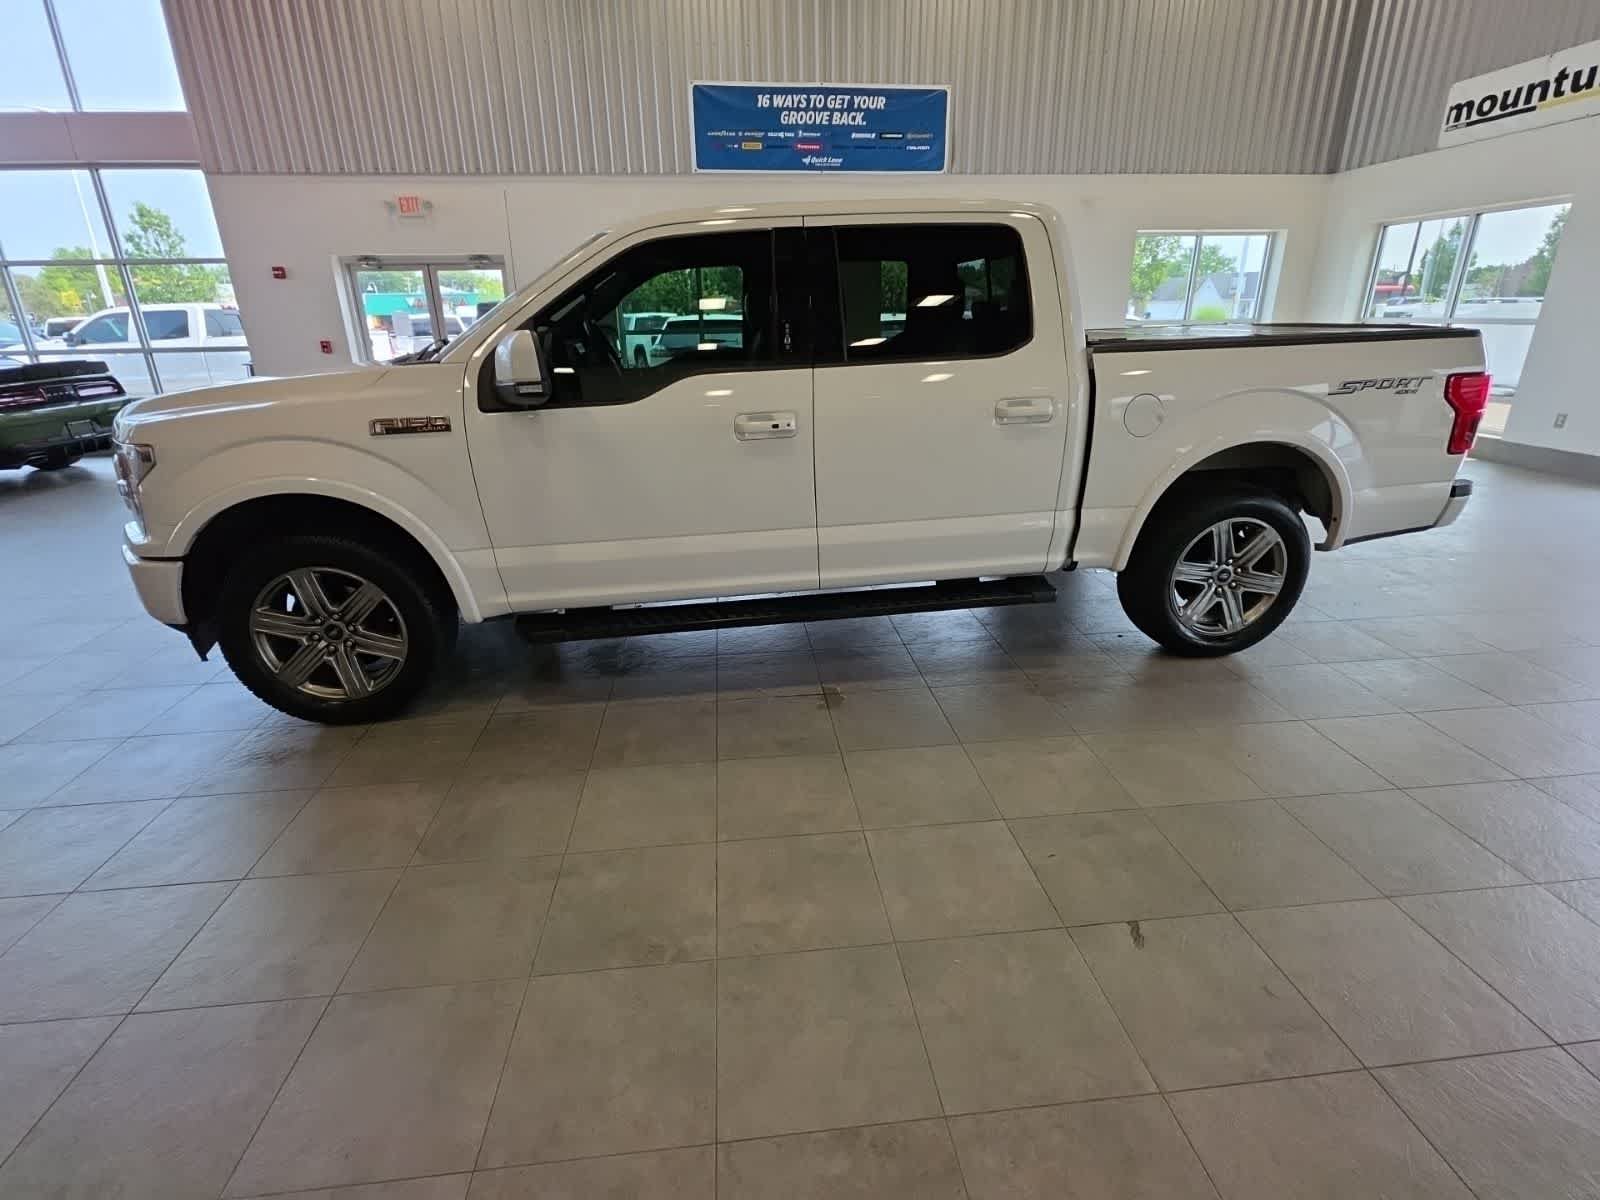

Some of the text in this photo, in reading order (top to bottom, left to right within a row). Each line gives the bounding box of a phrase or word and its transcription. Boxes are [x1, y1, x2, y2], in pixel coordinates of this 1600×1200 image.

[757, 94, 886, 111] 16 WAYS TO GET YOUR
[1446, 65, 1600, 125] mountu
[780, 111, 867, 126] GROOVE BACK.
[399, 196, 419, 213] EXIT
[1327, 376, 1434, 395] SPORT
